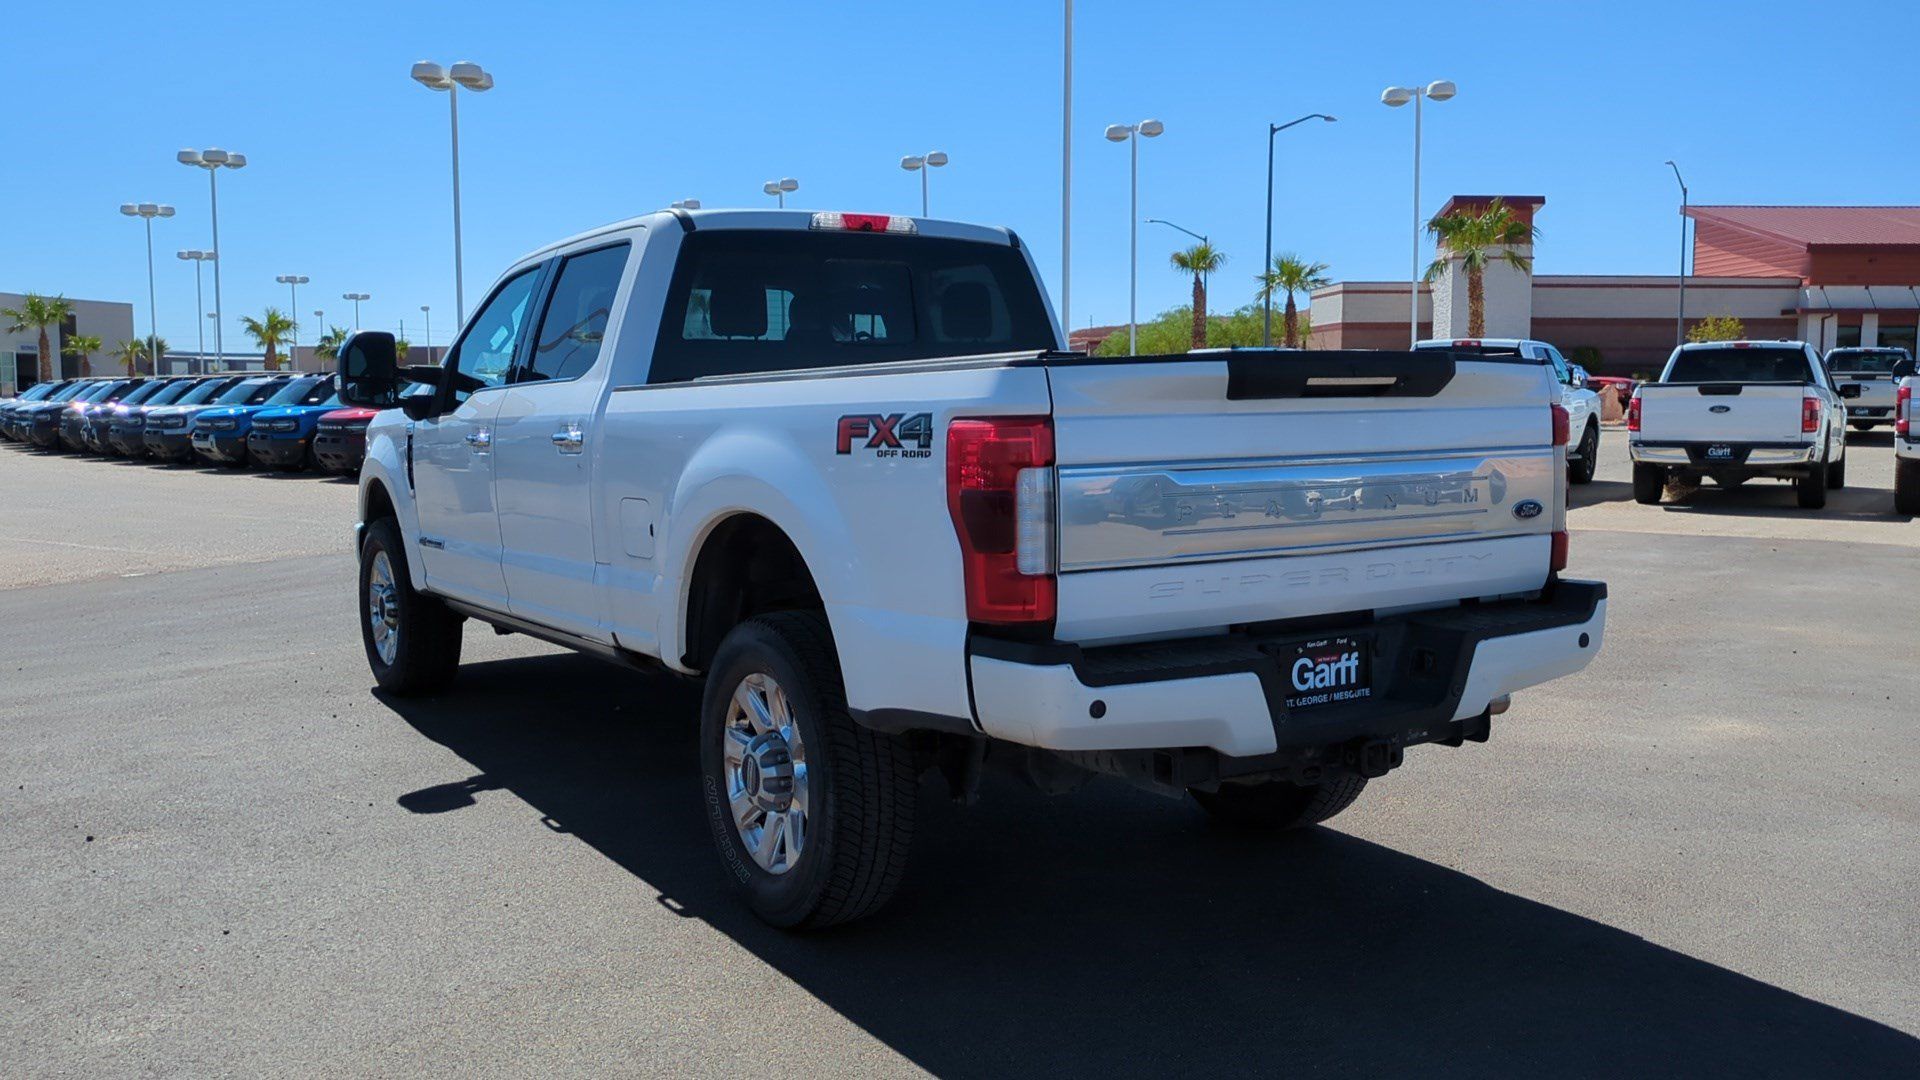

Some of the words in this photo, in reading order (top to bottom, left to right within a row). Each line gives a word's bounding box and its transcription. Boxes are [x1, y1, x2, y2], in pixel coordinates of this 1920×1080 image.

[836, 413, 933, 455] FX4
[877, 450, 897, 458] OFF
[902, 450, 931, 458] ROAD
[1708, 447, 1731, 456] Garff
[1177, 488, 1480, 522] PLATINUM
[1150, 566, 1349, 599] SUPER
[1367, 553, 1493, 582] DUTY
[1291, 651, 1359, 692] Garff
[1296, 693, 1329, 707] GEORGE
[1333, 687, 1371, 701] MESQUITE
